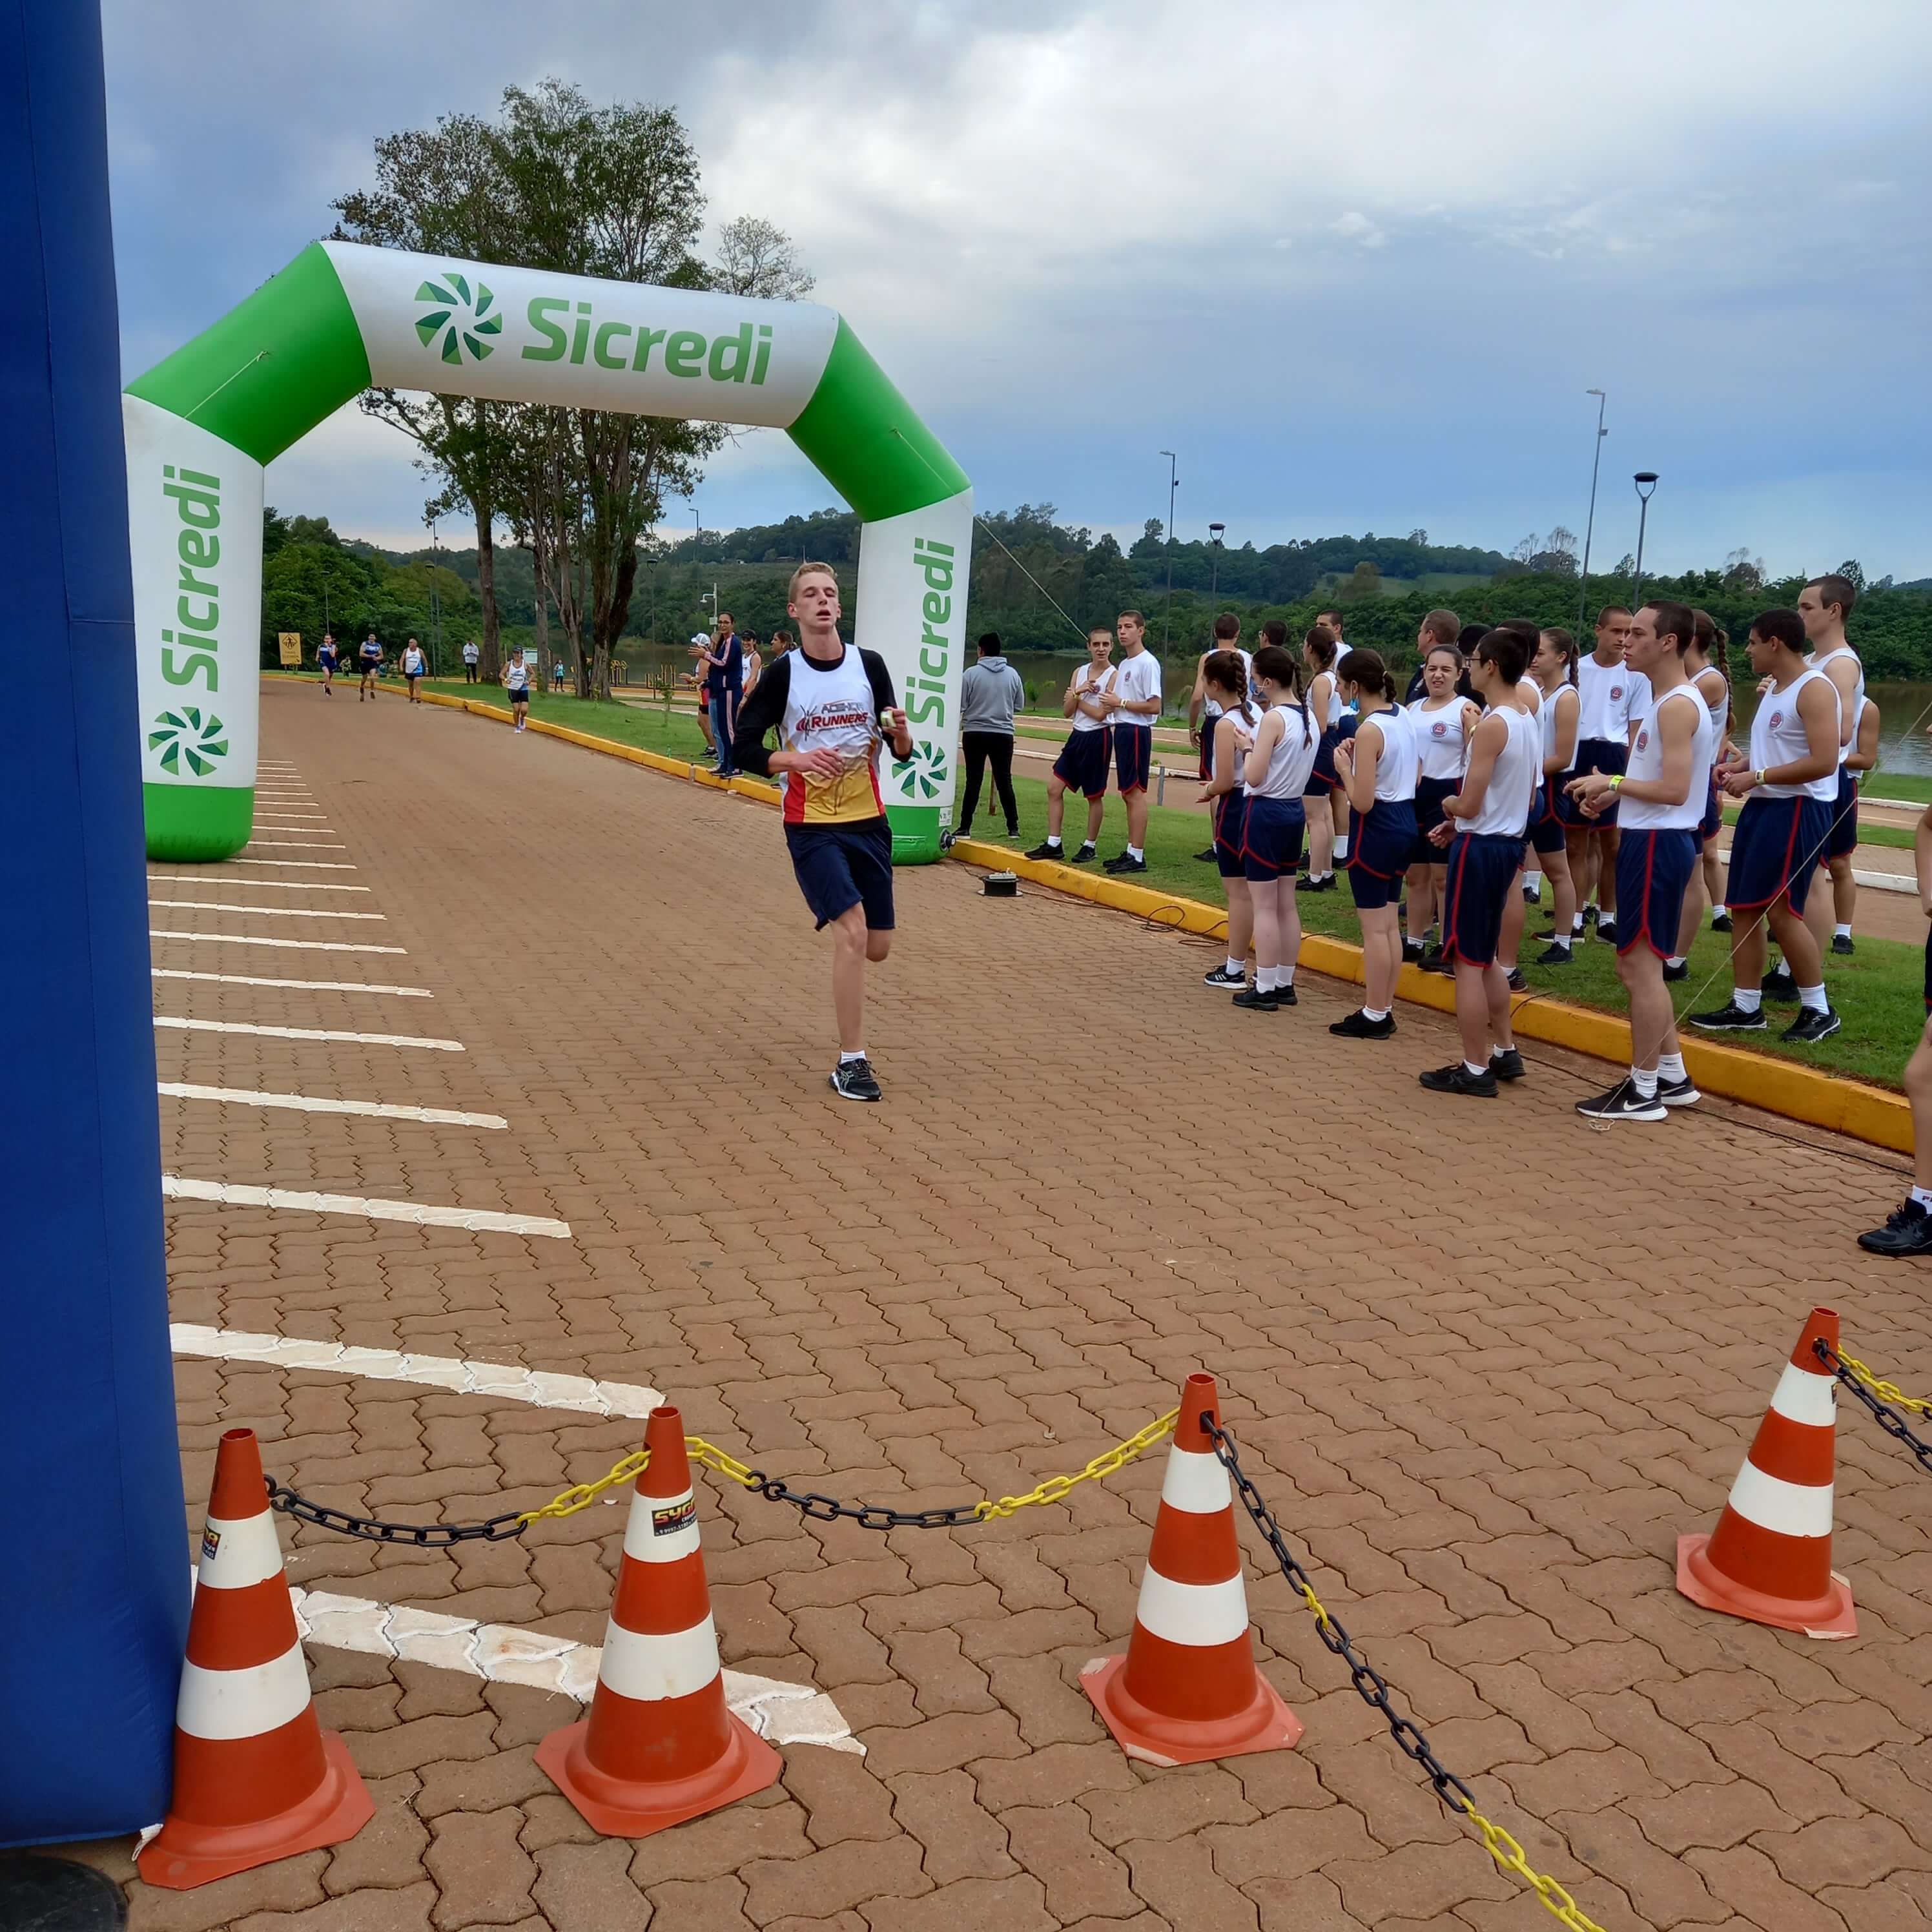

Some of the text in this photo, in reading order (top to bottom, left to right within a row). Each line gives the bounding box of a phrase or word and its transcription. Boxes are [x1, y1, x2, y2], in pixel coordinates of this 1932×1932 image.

[522, 297, 773, 385] Sicredi
[161, 465, 220, 692] Sicredi
[905, 537, 954, 728] Sicredi
[811, 712, 868, 728] RUNNERS
